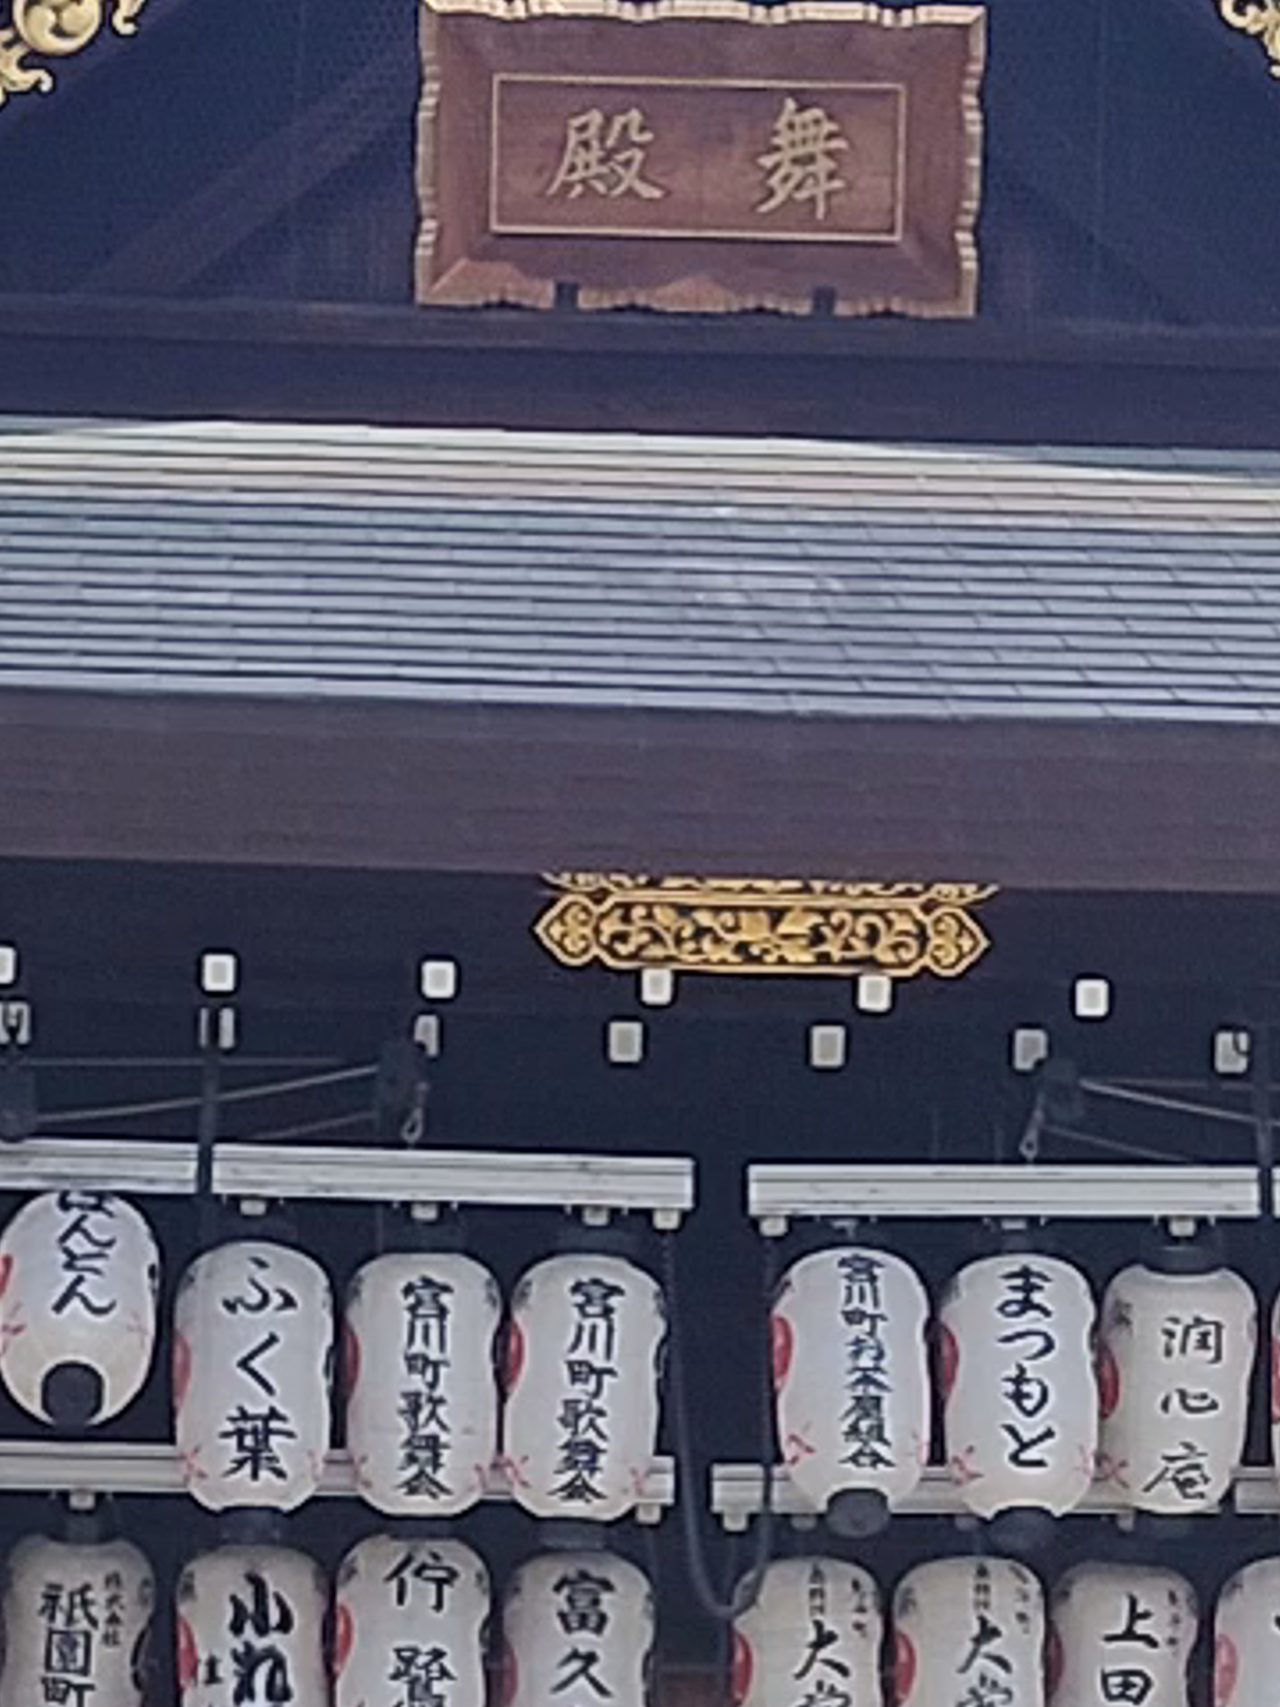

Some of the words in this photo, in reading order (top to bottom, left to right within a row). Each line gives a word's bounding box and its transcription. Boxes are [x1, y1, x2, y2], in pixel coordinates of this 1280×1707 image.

[220, 1257, 298, 1483] ふく葉
[996, 1266, 1058, 1470] まつもと
